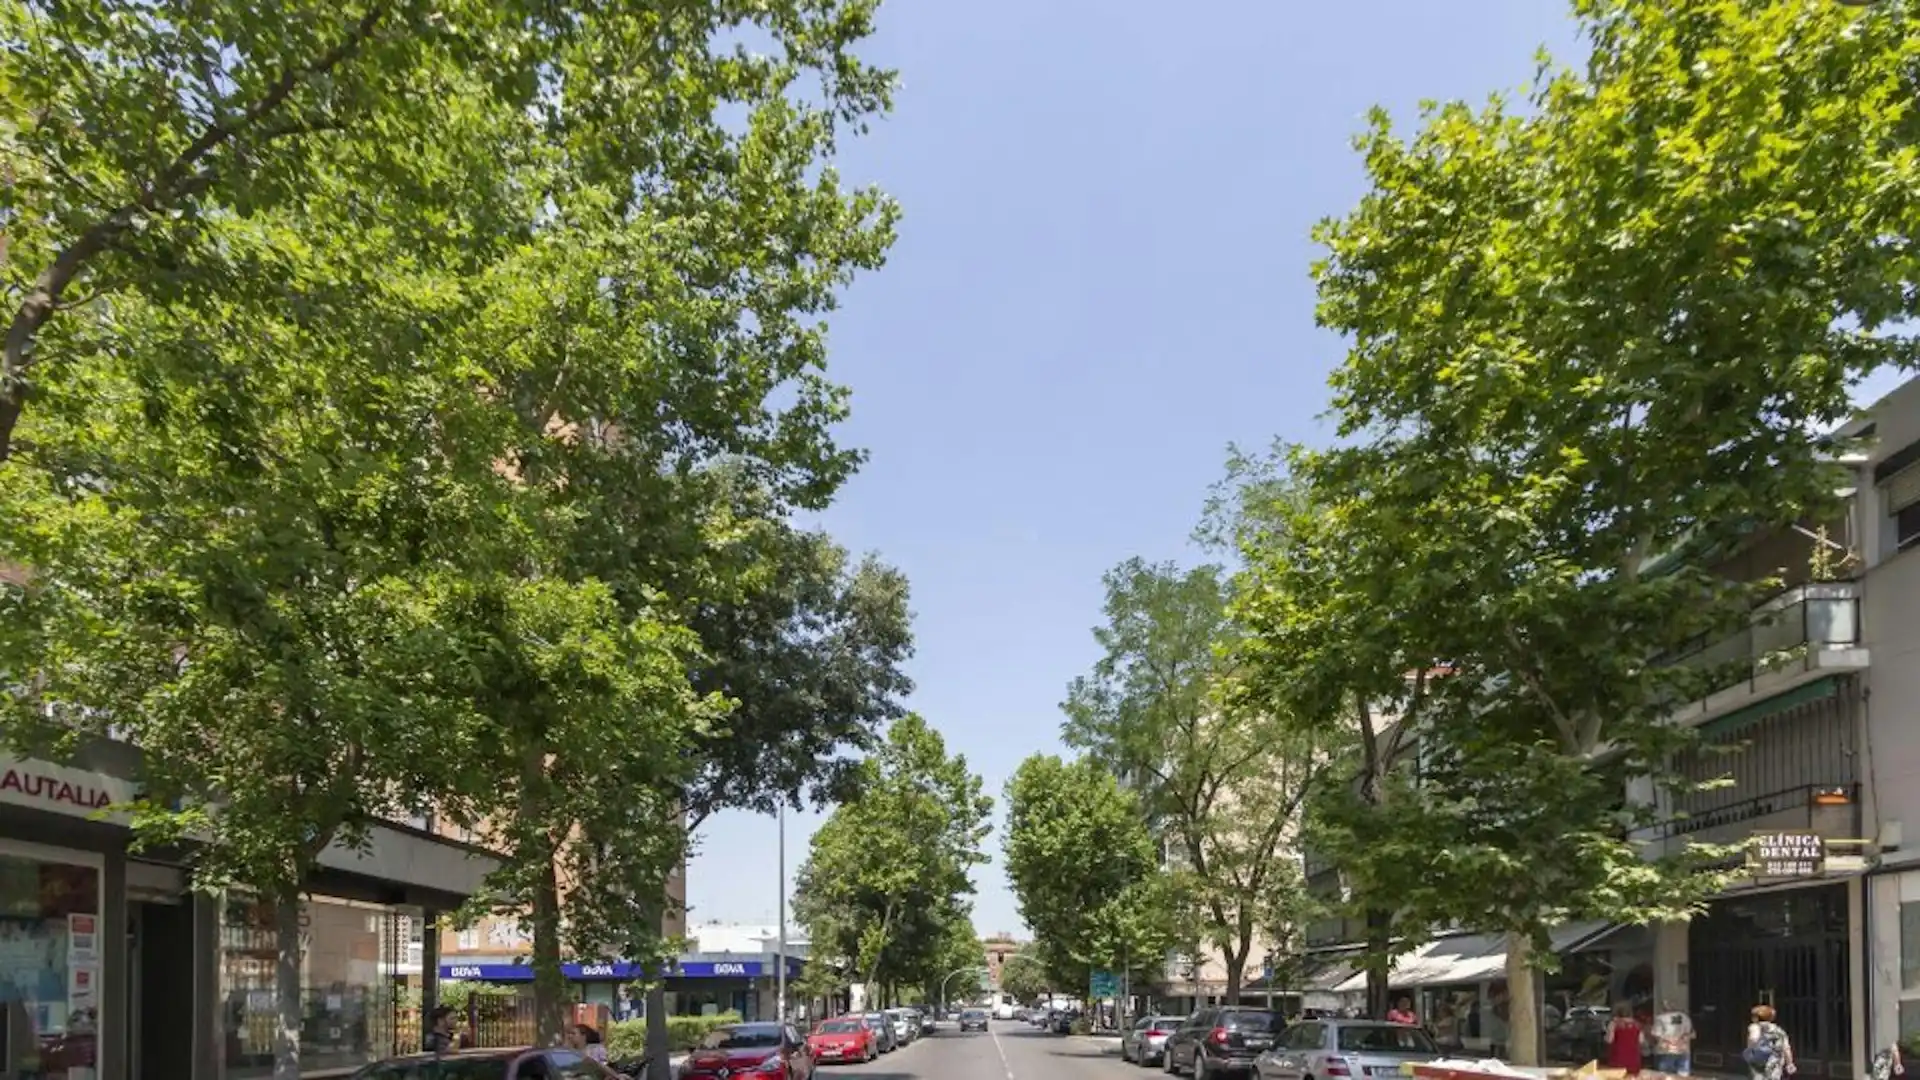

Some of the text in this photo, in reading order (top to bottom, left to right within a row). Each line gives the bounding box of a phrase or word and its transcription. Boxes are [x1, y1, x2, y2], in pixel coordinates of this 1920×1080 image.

[0, 769, 112, 808] AUTALIA
[1759, 833, 1820, 847] CLÍNICA
[1760, 847, 1821, 857] DENTAL
[714, 963, 745, 975] BBVA
